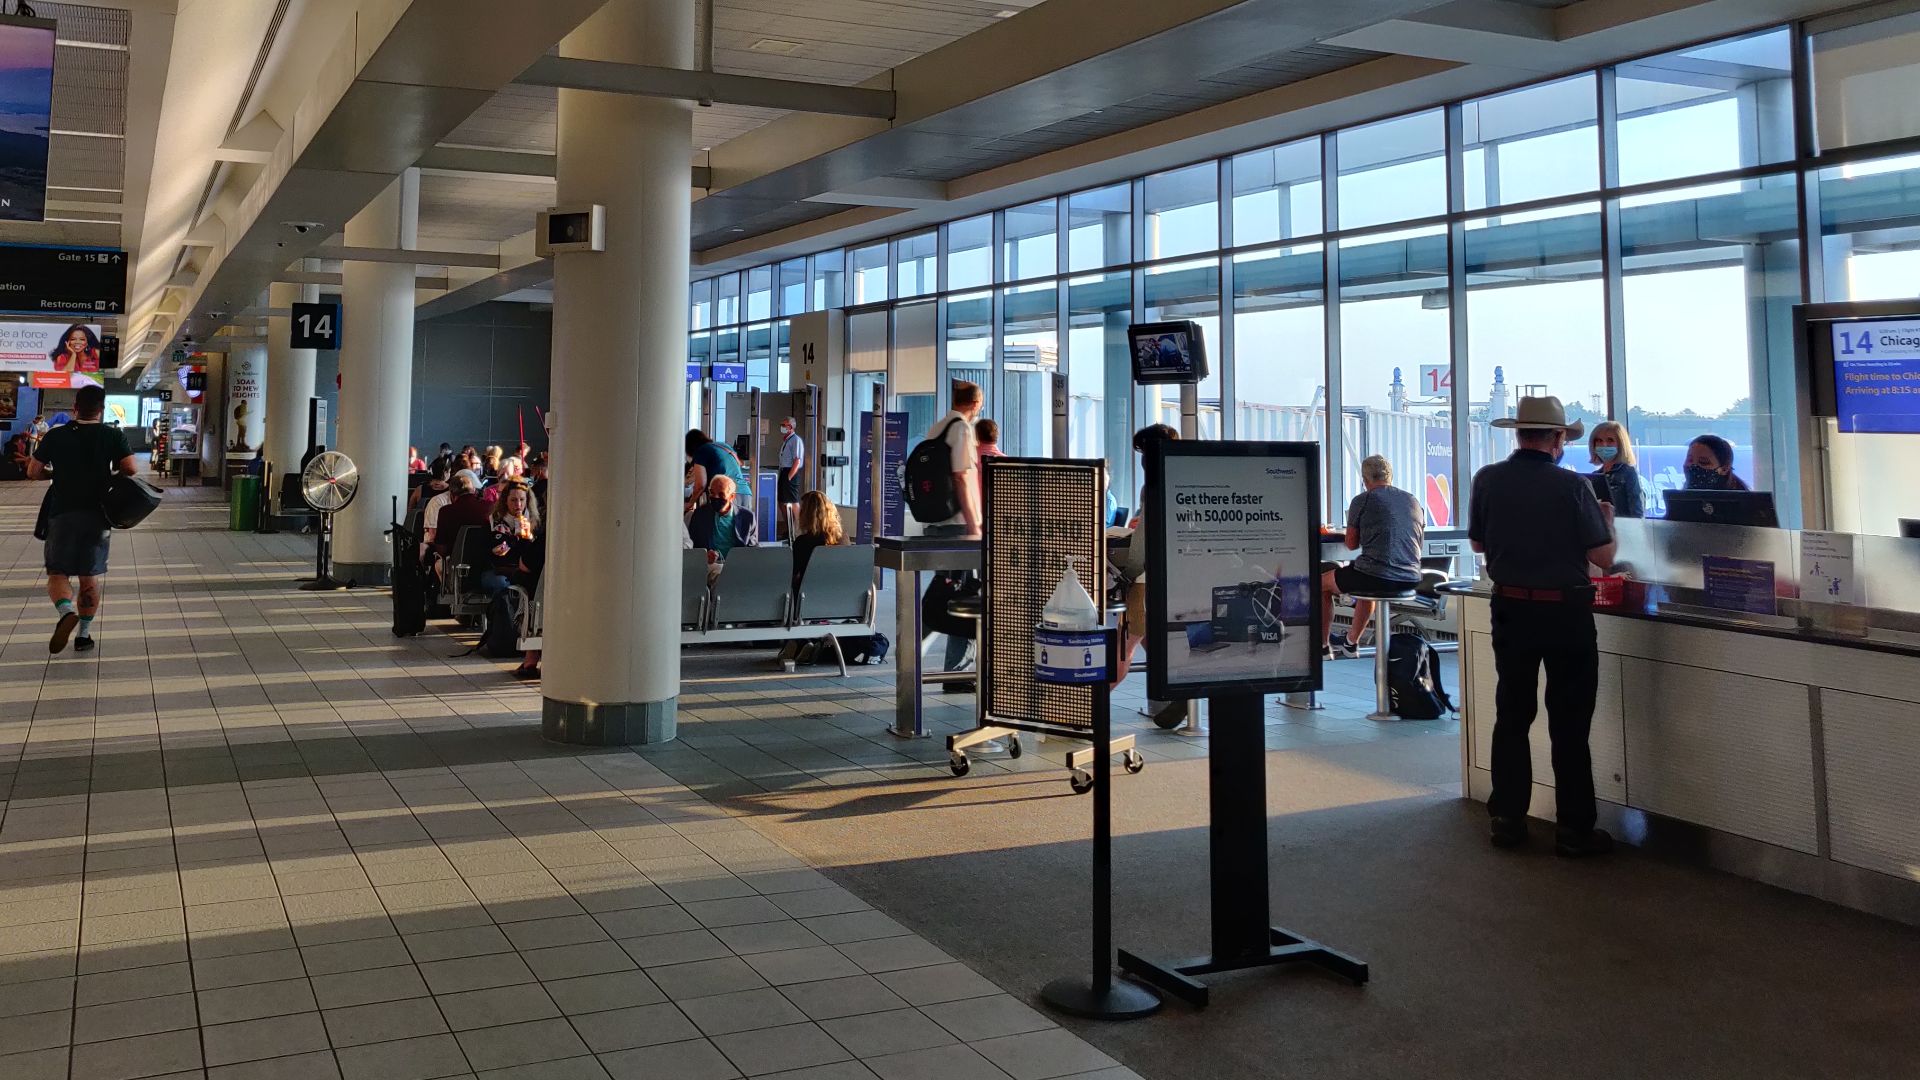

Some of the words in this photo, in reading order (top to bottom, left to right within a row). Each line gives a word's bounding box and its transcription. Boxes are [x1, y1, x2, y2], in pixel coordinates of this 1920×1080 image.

[58, 253, 81, 262] Gate
[85, 254, 96, 262] 15
[40, 299, 92, 310] Restrooms
[298, 314, 332, 338] 14
[22, 330, 48, 340] force
[16, 341, 43, 352] good
[1840, 330, 1874, 354] 14
[802, 343, 814, 364] 14
[1844, 373, 1869, 382] Flight
[1845, 386, 1880, 396] Arriving
[1891, 386, 1911, 394] 8:15
[1176, 492, 1196, 505] Get
[1199, 492, 1230, 505] there
[1231, 492, 1264, 505] faster
[1176, 509, 1202, 522] with
[1204, 509, 1244, 524] 50,000
[1245, 509, 1284, 524] points.
[1260, 632, 1278, 641] VISA
